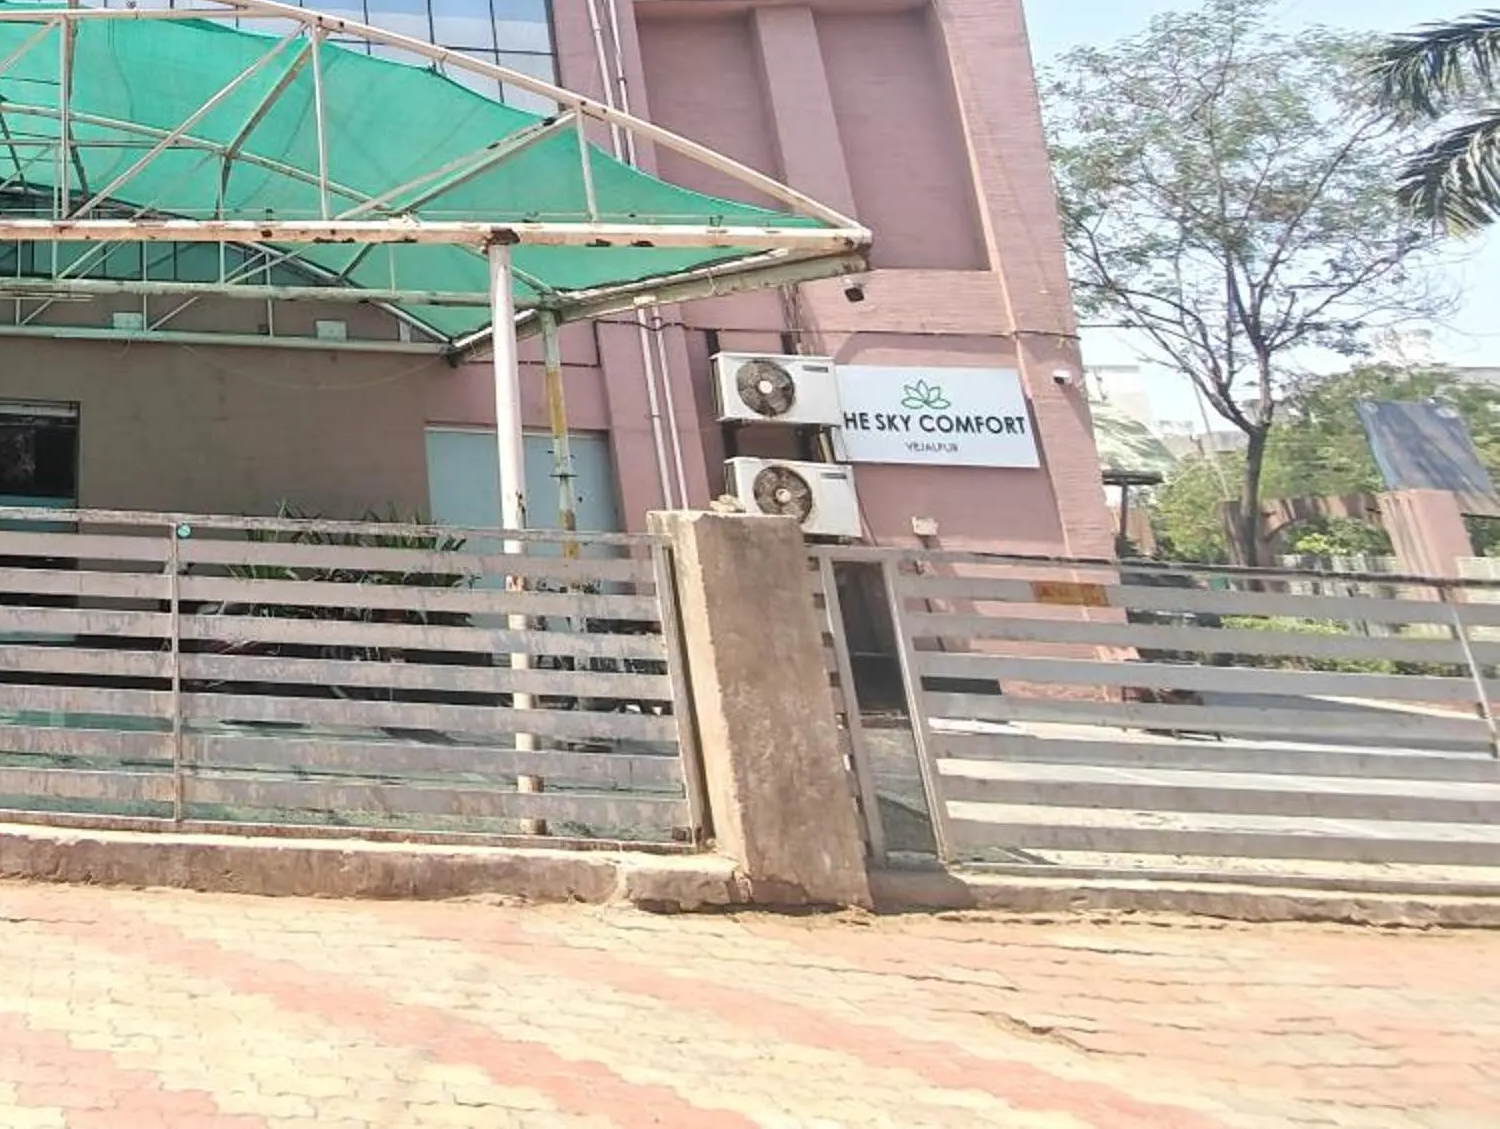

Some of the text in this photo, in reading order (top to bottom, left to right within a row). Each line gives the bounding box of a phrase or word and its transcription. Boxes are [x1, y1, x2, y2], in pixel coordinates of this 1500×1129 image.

[843, 411, 1027, 435] HE SKY COMFORT
